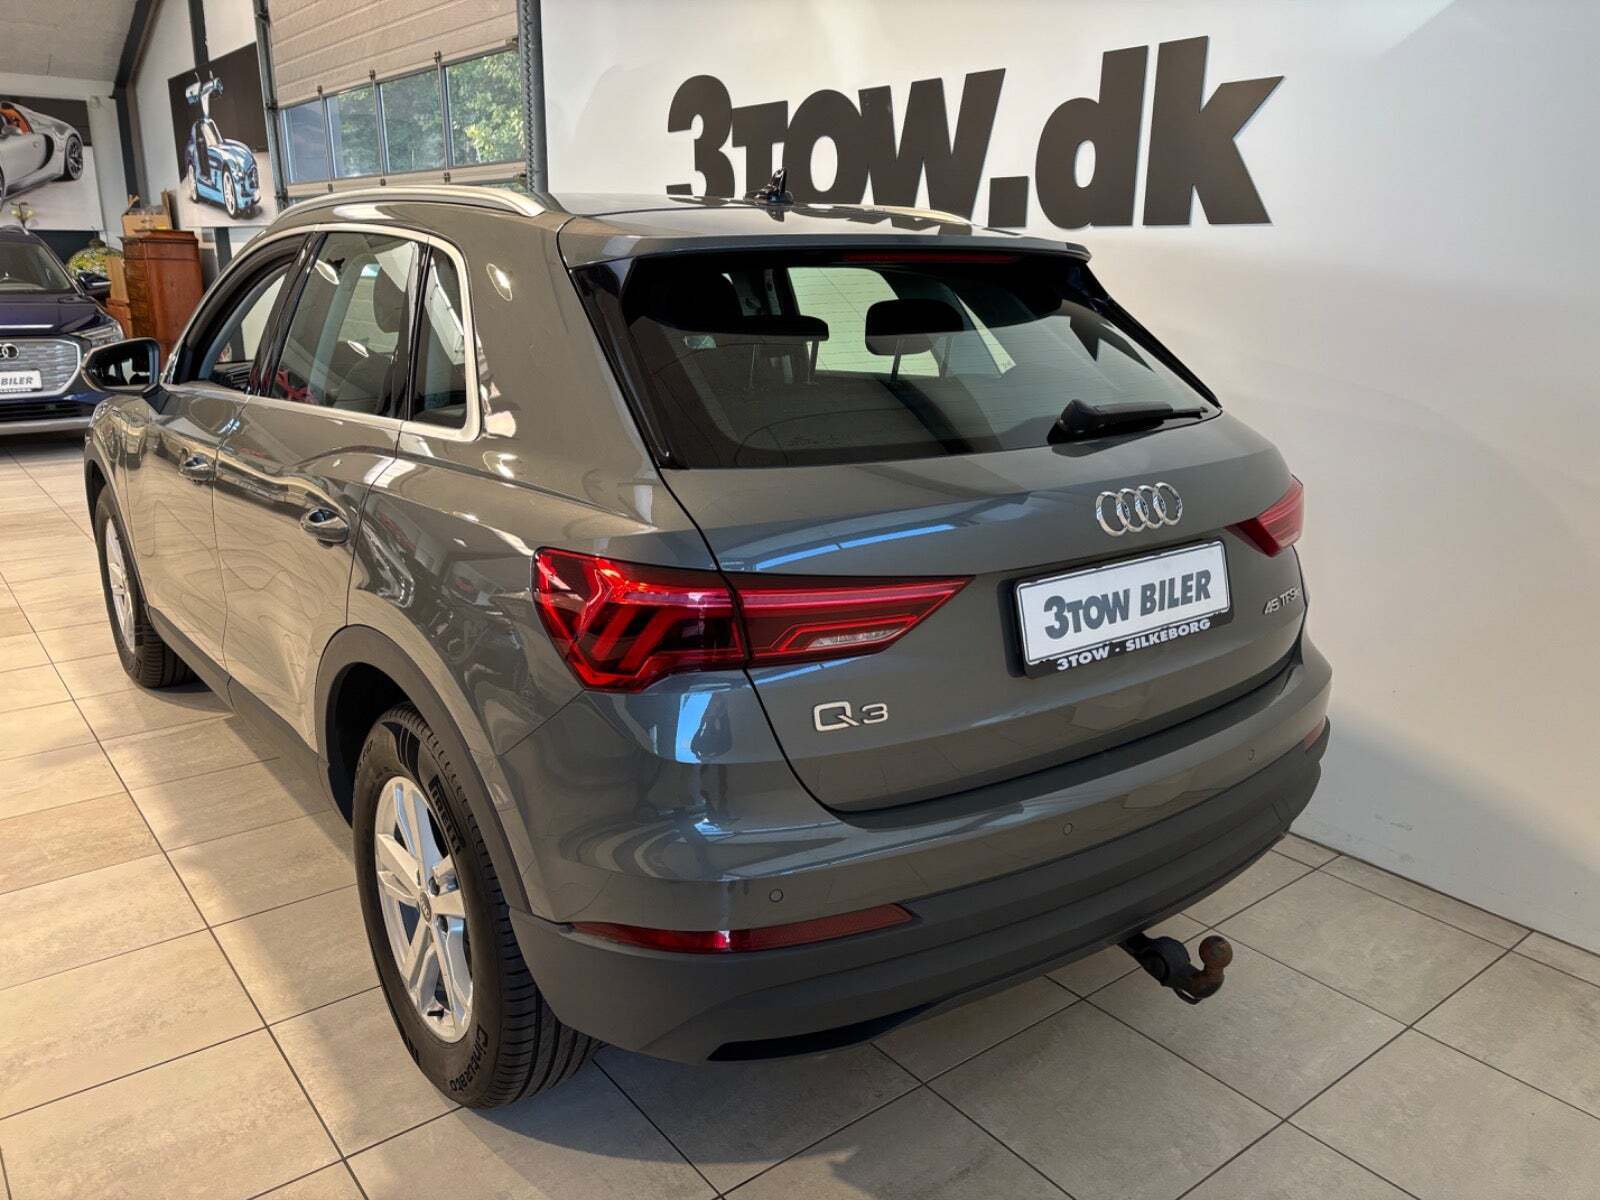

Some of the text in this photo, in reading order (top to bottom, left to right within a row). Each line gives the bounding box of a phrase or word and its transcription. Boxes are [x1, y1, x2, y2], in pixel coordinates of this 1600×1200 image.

[1, 376, 33, 386] BILER
[1044, 569, 1212, 640] 3TOW BILER
[1263, 597, 1280, 615] 45
[1057, 645, 1110, 671] 3TOW
[1125, 618, 1211, 651] SILKEBORG
[814, 701, 888, 731] Q3
